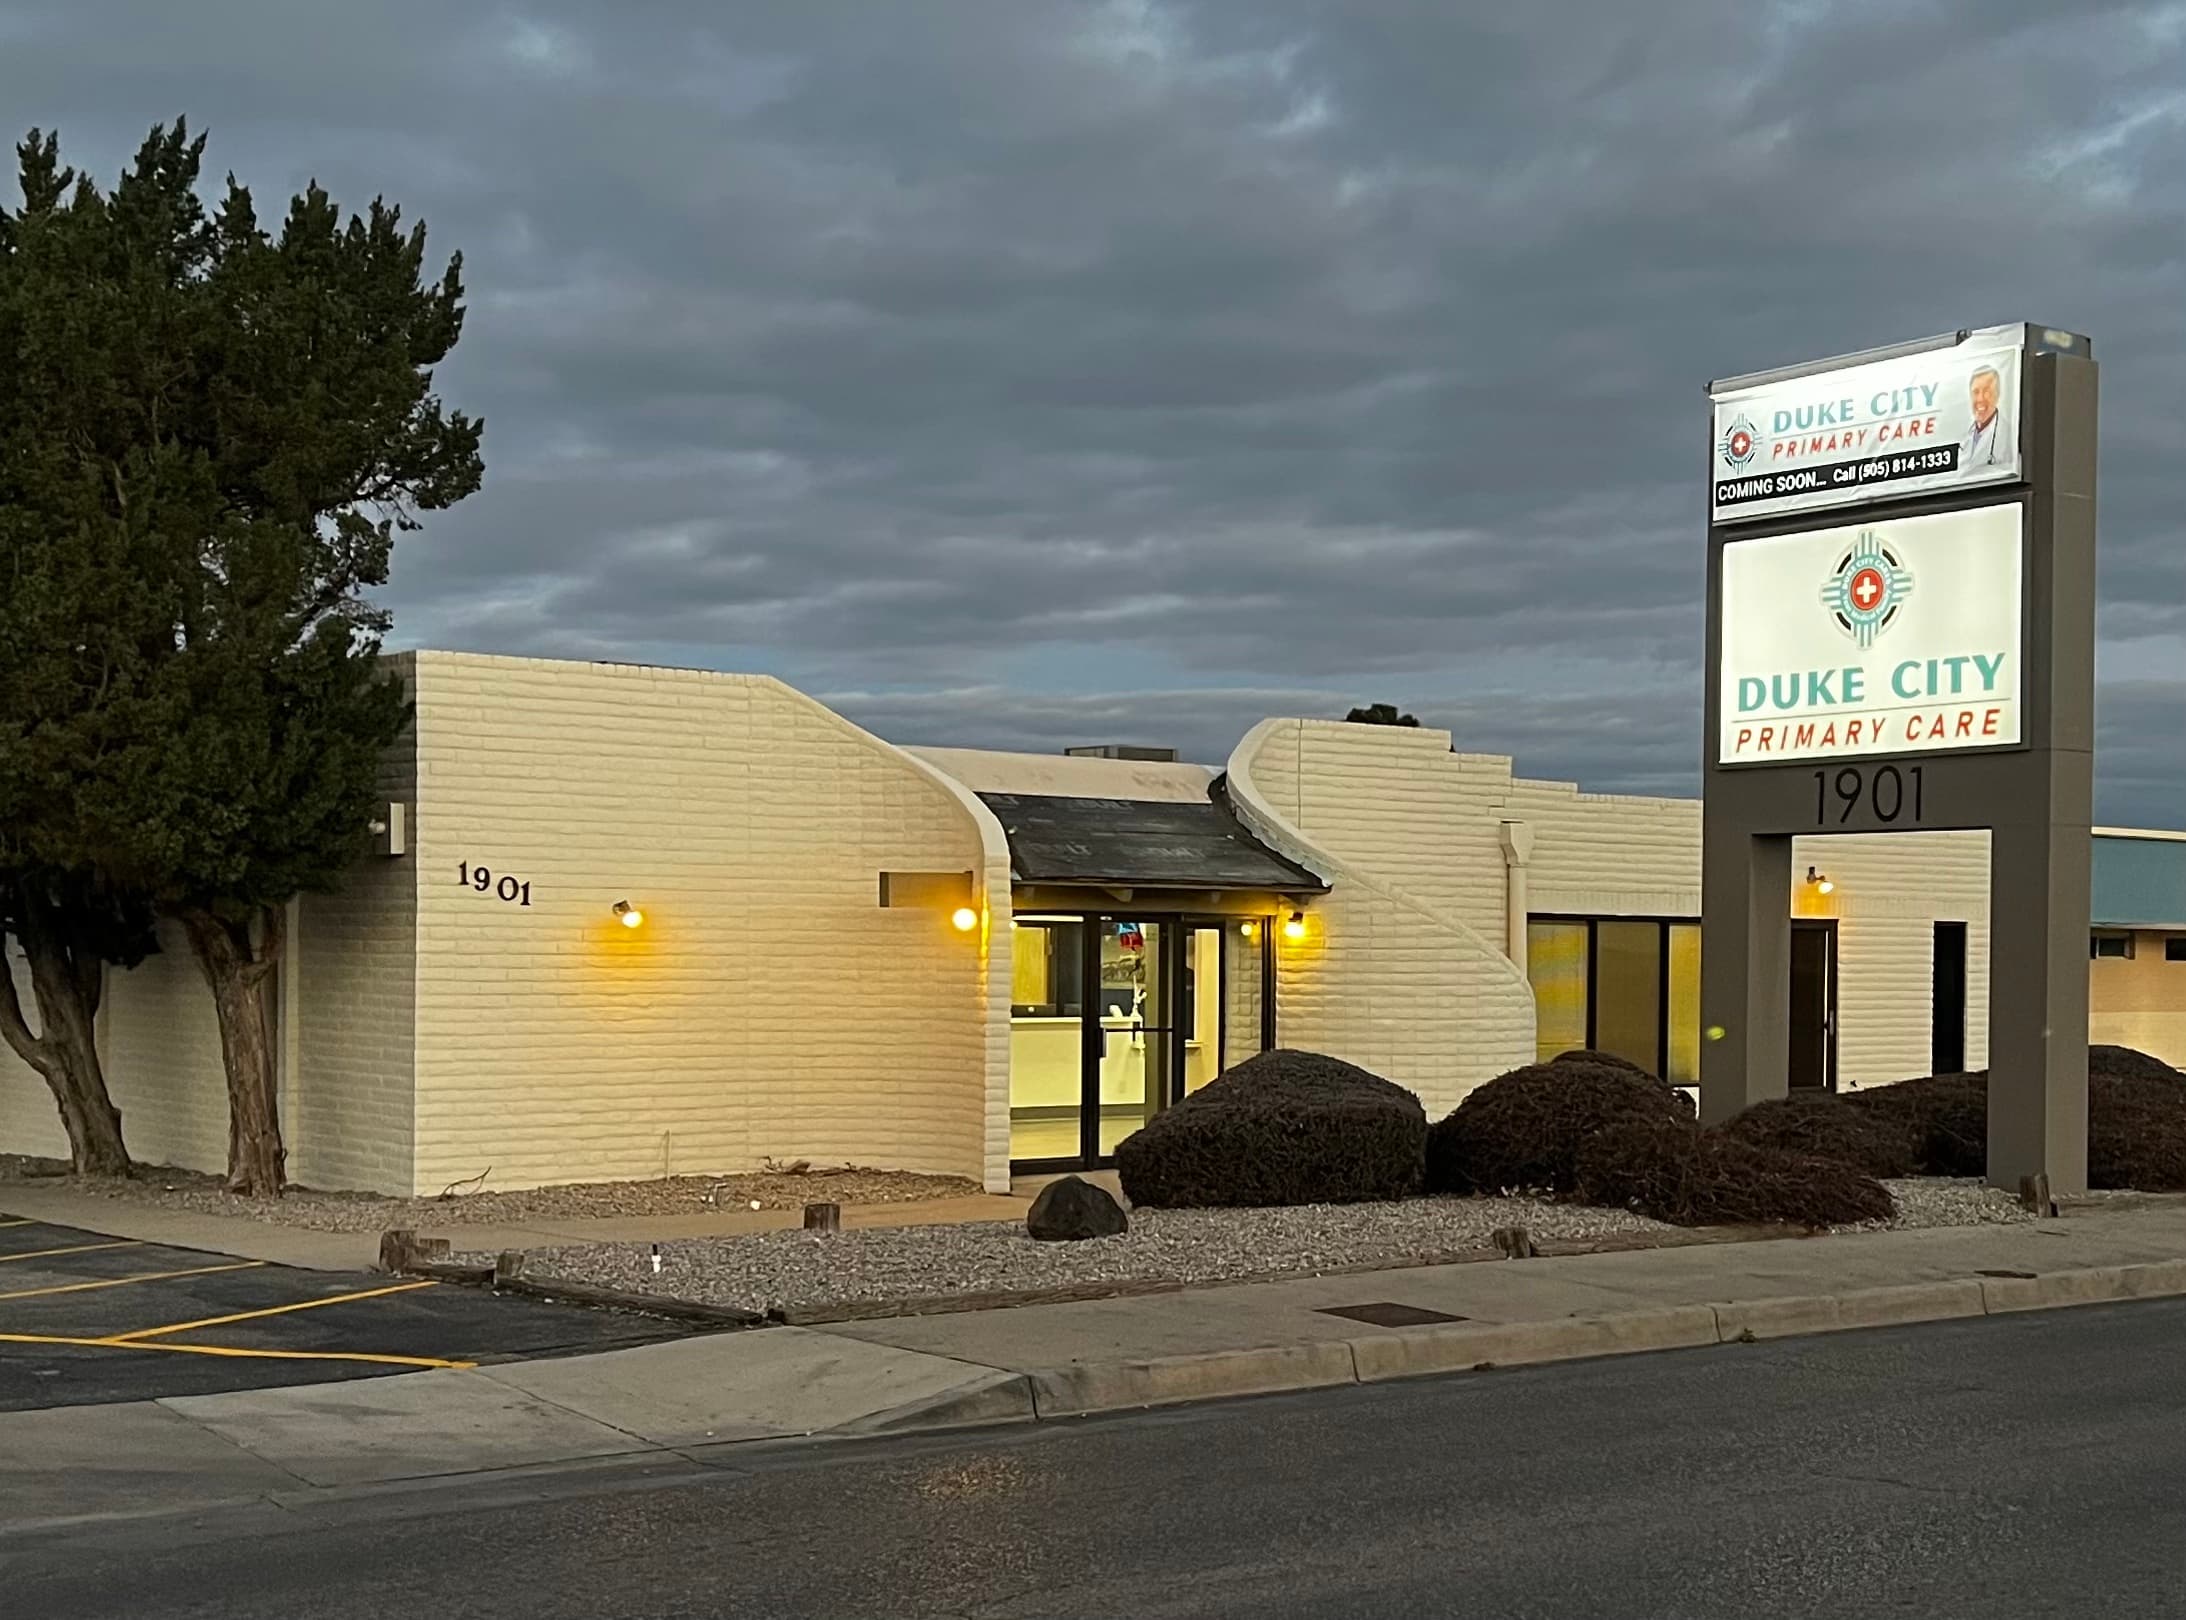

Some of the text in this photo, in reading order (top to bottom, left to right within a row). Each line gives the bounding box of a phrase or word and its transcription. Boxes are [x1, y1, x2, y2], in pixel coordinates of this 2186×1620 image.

[1774, 382, 1938, 433] DUKE CITY
[1772, 417, 1936, 460] PRIMARY CARE
[1718, 451, 1951, 500] COMING SOON... Call (505) 814-1333
[1738, 653, 2005, 712] DUKE CITY
[1736, 709, 2001, 753] PRIMARY CARE
[1814, 765, 1923, 824] 1901
[459, 860, 531, 906] 1901
